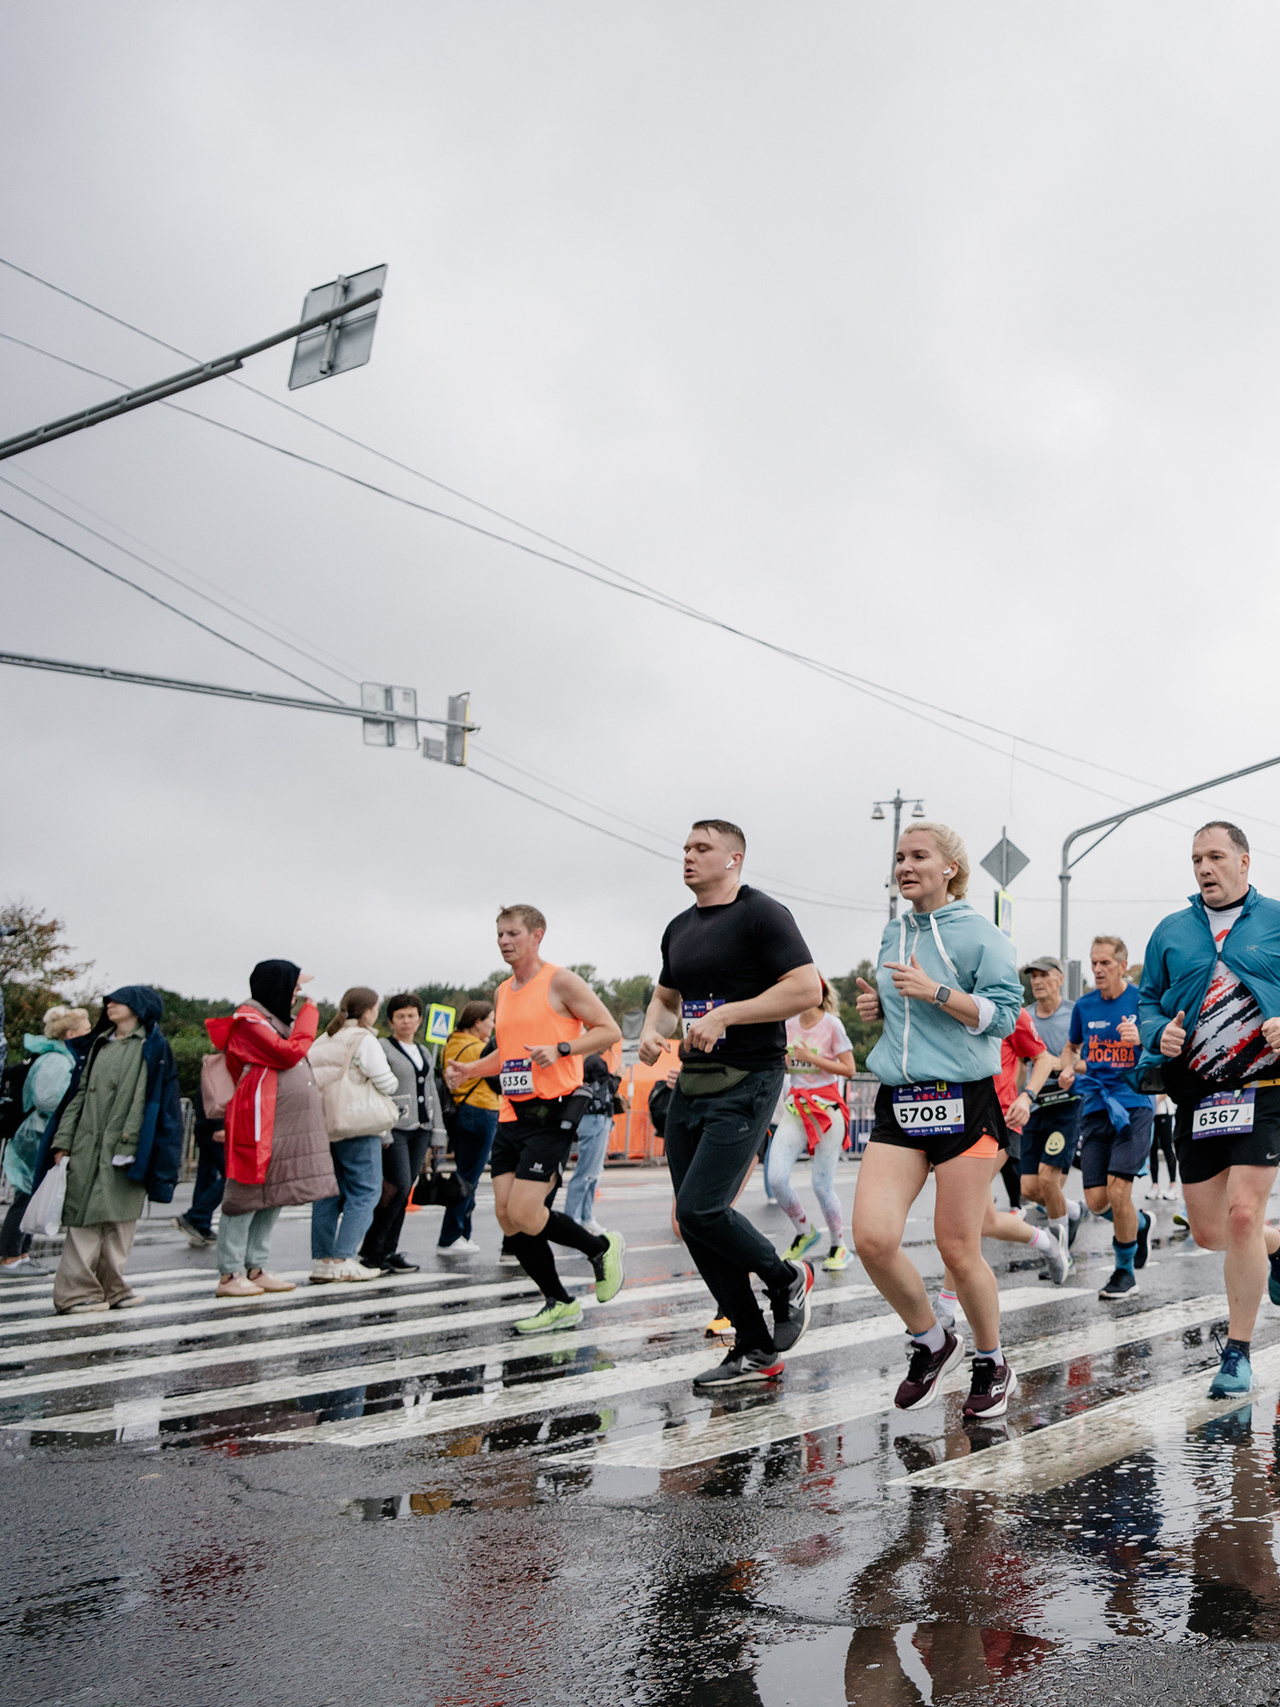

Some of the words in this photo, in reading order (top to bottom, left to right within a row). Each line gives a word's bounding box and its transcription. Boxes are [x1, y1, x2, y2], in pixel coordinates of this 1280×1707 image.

[1087, 1048, 1135, 1062] МОСКВА
[502, 1075, 528, 1087] 6336
[900, 1105, 947, 1124] 5708
[1199, 1109, 1239, 1127] 6367
